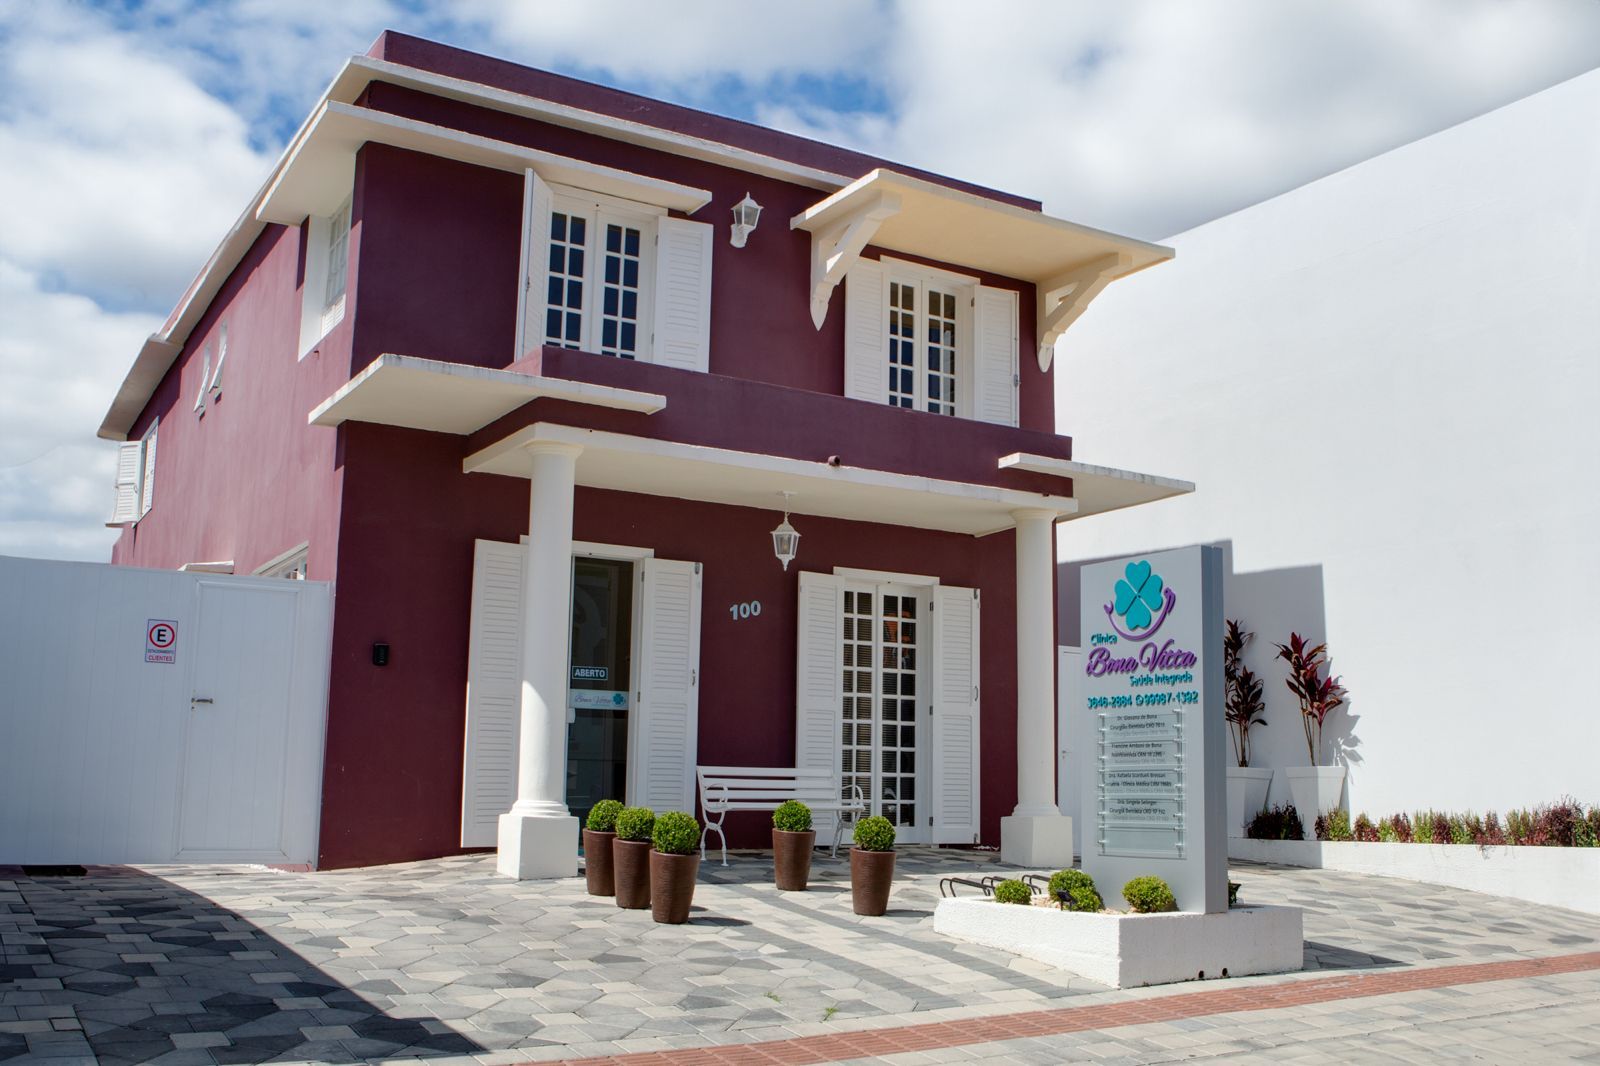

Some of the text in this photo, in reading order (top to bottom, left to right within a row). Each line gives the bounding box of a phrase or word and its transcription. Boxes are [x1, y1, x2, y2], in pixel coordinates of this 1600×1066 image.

[730, 600, 761, 620] 100
[157, 629, 167, 642] E
[1086, 639, 1198, 677] Bona Vitta
[575, 668, 606, 678] ABERTO
[1155, 671, 1193, 686] Integrada
